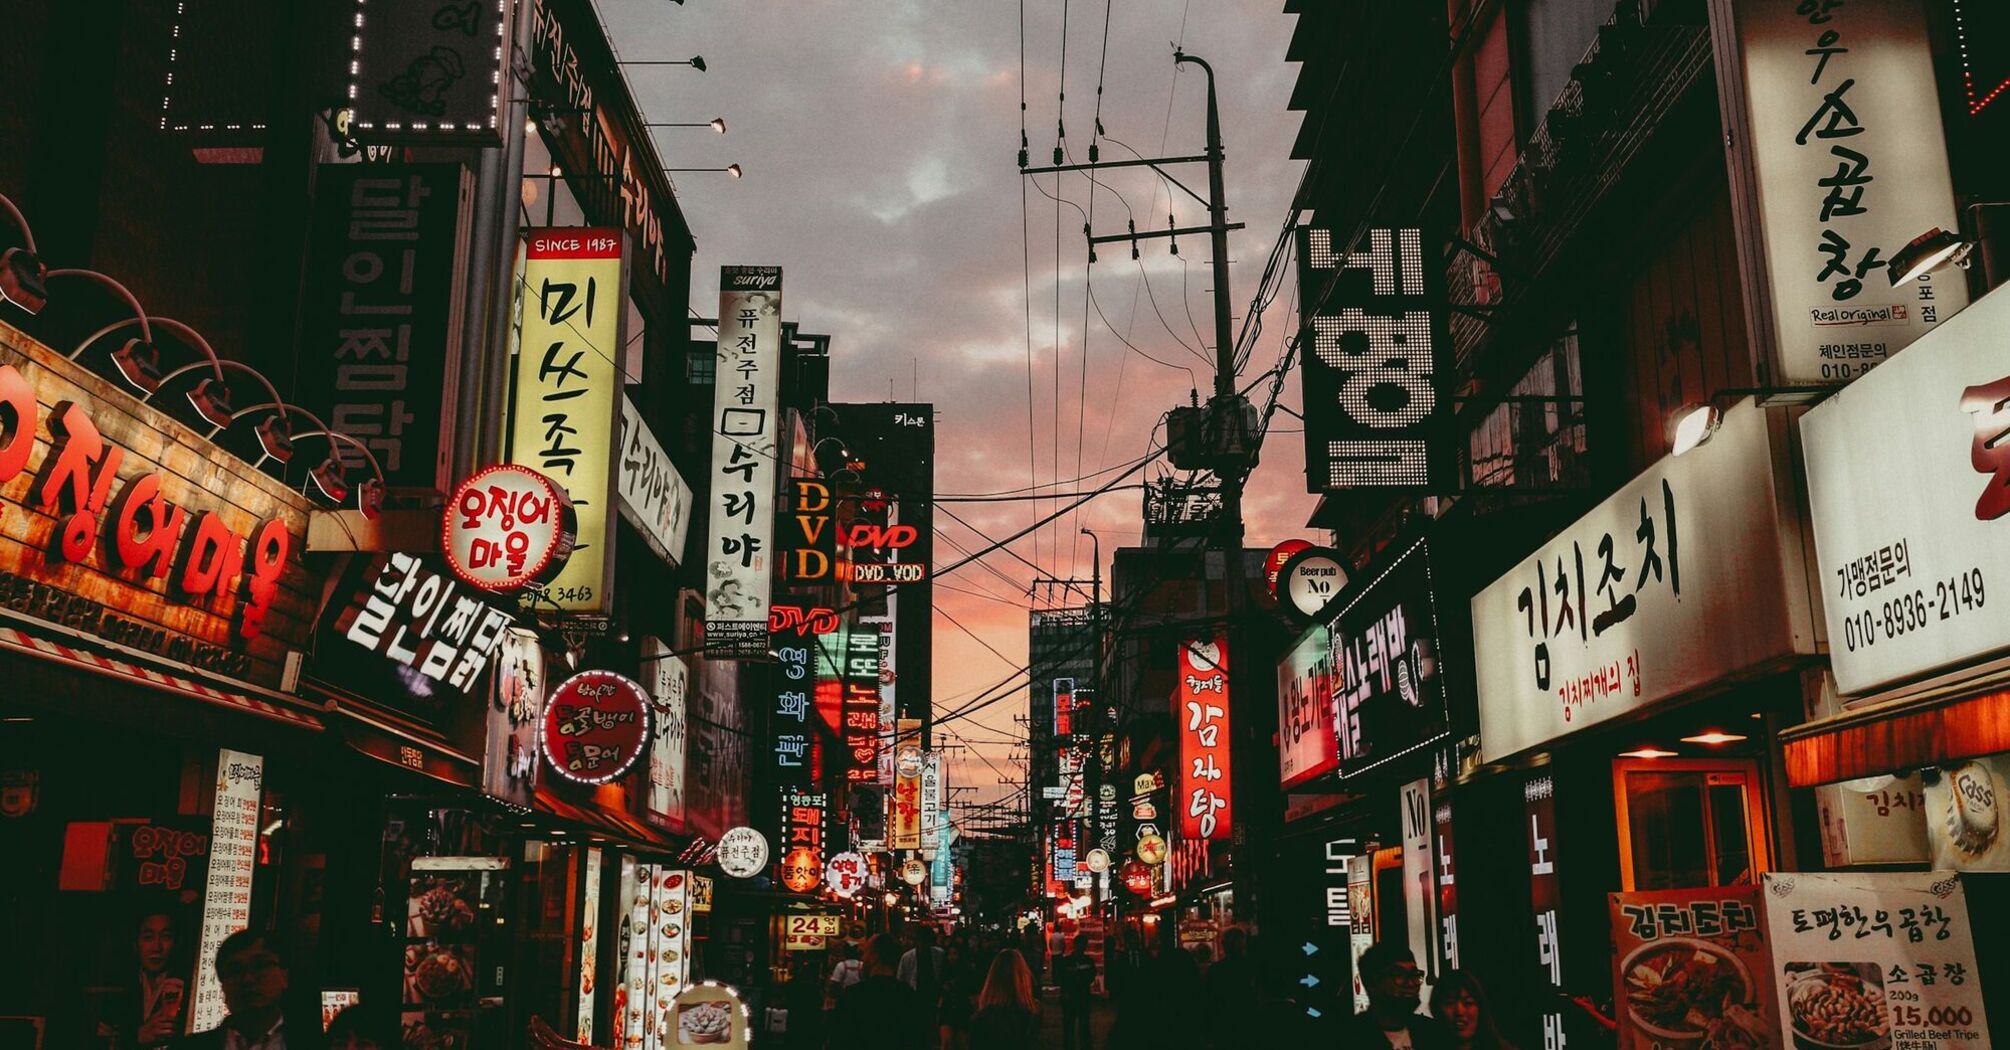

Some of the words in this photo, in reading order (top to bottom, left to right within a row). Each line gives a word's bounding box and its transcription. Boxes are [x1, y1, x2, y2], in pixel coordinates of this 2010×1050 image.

[535, 238, 581, 252] SINCE
[586, 236, 618, 251] 1987
[732, 273, 777, 290] suriya
[330, 174, 432, 472] 달인찜닭
[1811, 308, 1839, 322] Real
[734, 307, 760, 406] 퓨전주점
[1819, 342, 1888, 360] 체인점문의
[536, 274, 595, 552] 미쓰족
[458, 484, 551, 532] 오징어
[721, 442, 762, 568] 수리야
[795, 481, 831, 580] DVD
[849, 524, 918, 549] DVD
[468, 531, 530, 577] 마을
[1300, 566, 1319, 576] Beer
[1320, 567, 1337, 577] pub
[1836, 537, 1913, 601] 가맹점문의
[1517, 477, 1681, 692] 김치조치
[346, 550, 512, 695] 달인찜닭
[769, 605, 841, 637] DVD
[1843, 566, 1986, 653] 010-8936-2149
[1627, 648, 1642, 698] 집
[1185, 700, 1227, 838] 감자탕
[1958, 773, 1993, 808] Cass
[132, 826, 209, 858] 오징어
[721, 844, 760, 859] 퓨전주점
[138, 855, 188, 890] 마을
[792, 917, 820, 934] 24
[1888, 990, 1919, 1002] 200g
[1892, 1005, 1973, 1028] 15,000
[1894, 1029, 1926, 1040] Grilled
[1928, 1029, 1952, 1040] Beef
[1954, 1029, 1980, 1042] Tripe
